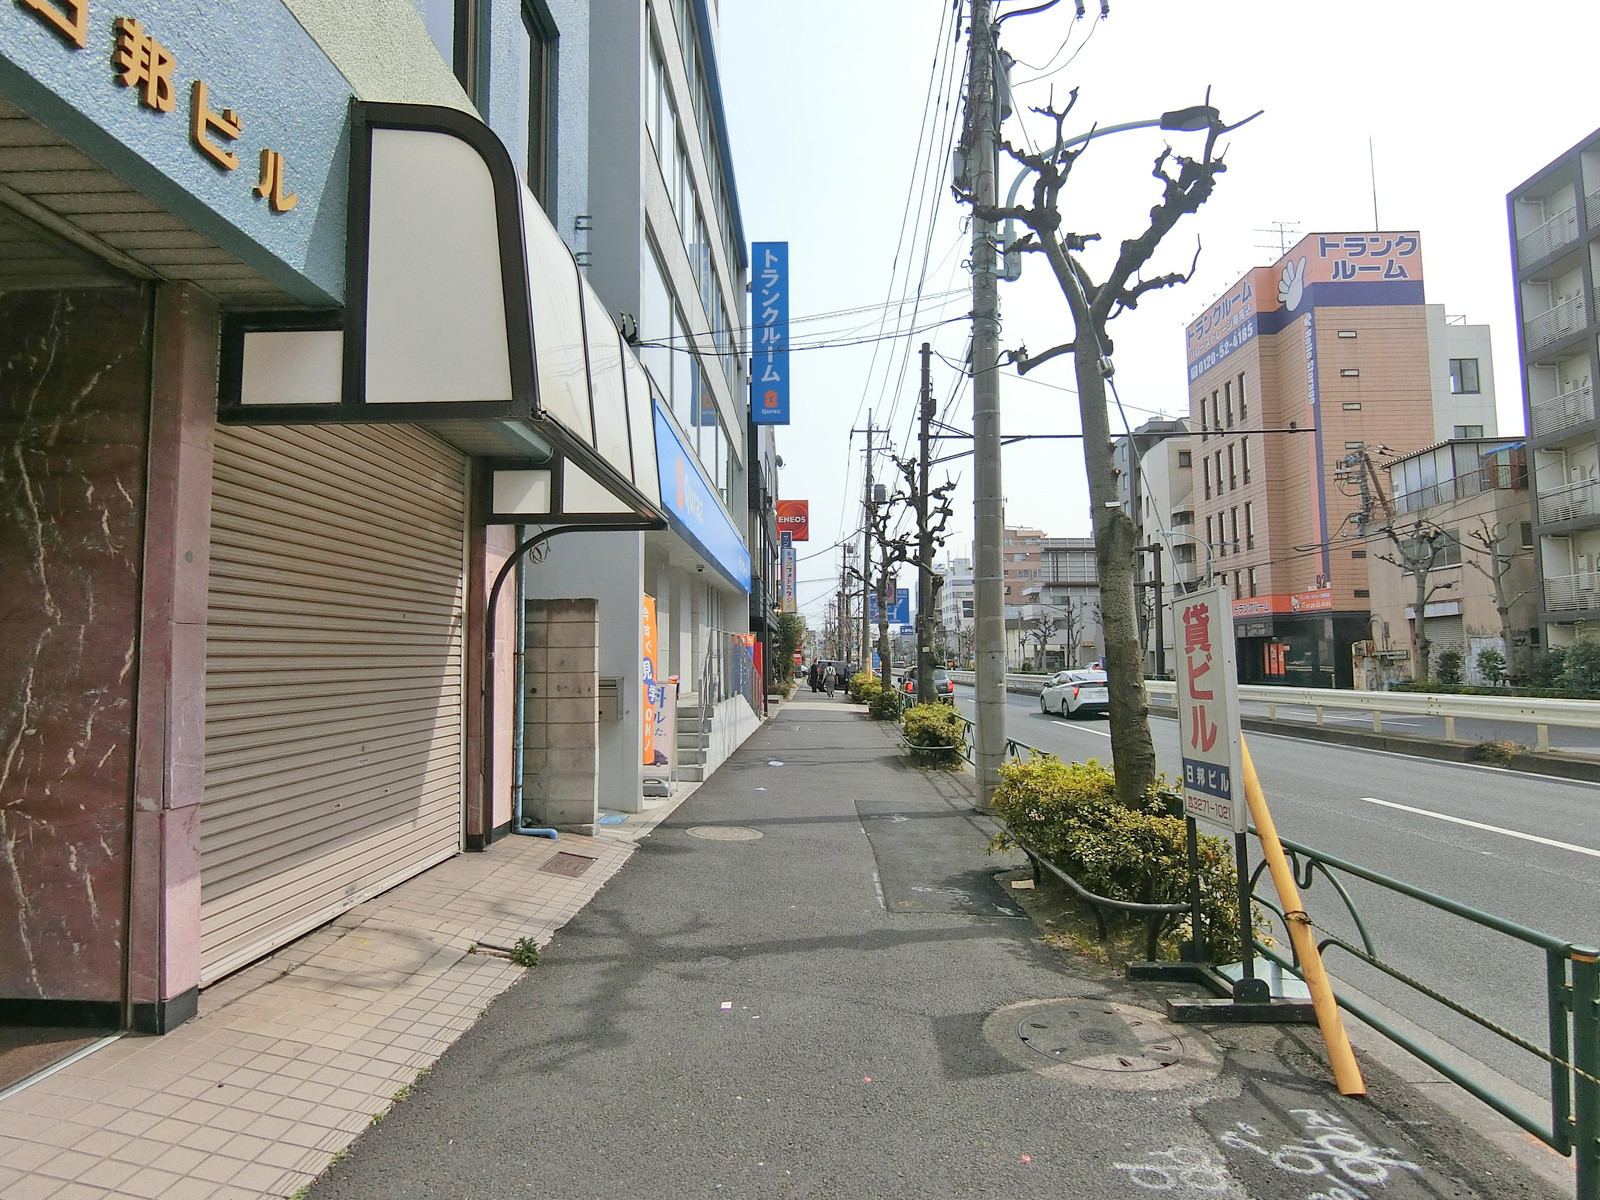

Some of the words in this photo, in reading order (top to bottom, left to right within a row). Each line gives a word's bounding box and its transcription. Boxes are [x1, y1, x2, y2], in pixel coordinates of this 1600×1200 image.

[1319, 235, 1417, 258] トランク
[1332, 259, 1408, 280] ルーム
[761, 249, 780, 382] トランクルーム
[1188, 281, 1253, 349] トランクルーム
[1198, 322, 1253, 374] 0120-52-4185
[1304, 327, 1313, 359] Hello
[1307, 360, 1316, 405] Storage
[1316, 574, 1327, 589] 92
[1234, 601, 1270, 615] トランクルーム
[1182, 602, 1218, 752] 貸ビル
[1186, 765, 1229, 792] 日邦ビル
